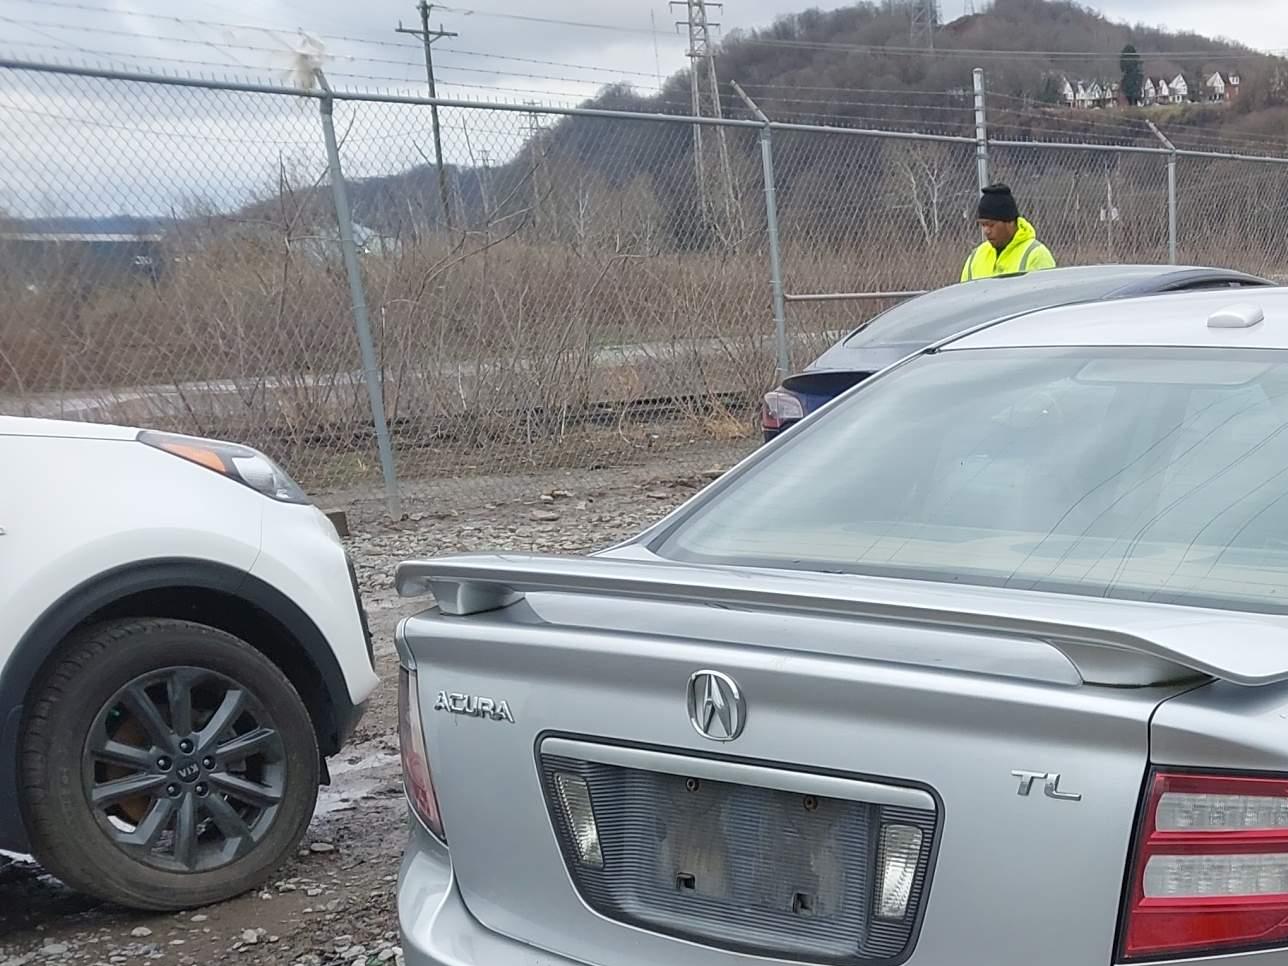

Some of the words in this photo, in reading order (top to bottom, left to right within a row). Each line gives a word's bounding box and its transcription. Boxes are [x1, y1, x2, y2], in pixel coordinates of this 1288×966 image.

[433, 690, 515, 723] ACURA
[177, 763, 199, 777] KIA
[1010, 768, 1082, 802] TL
